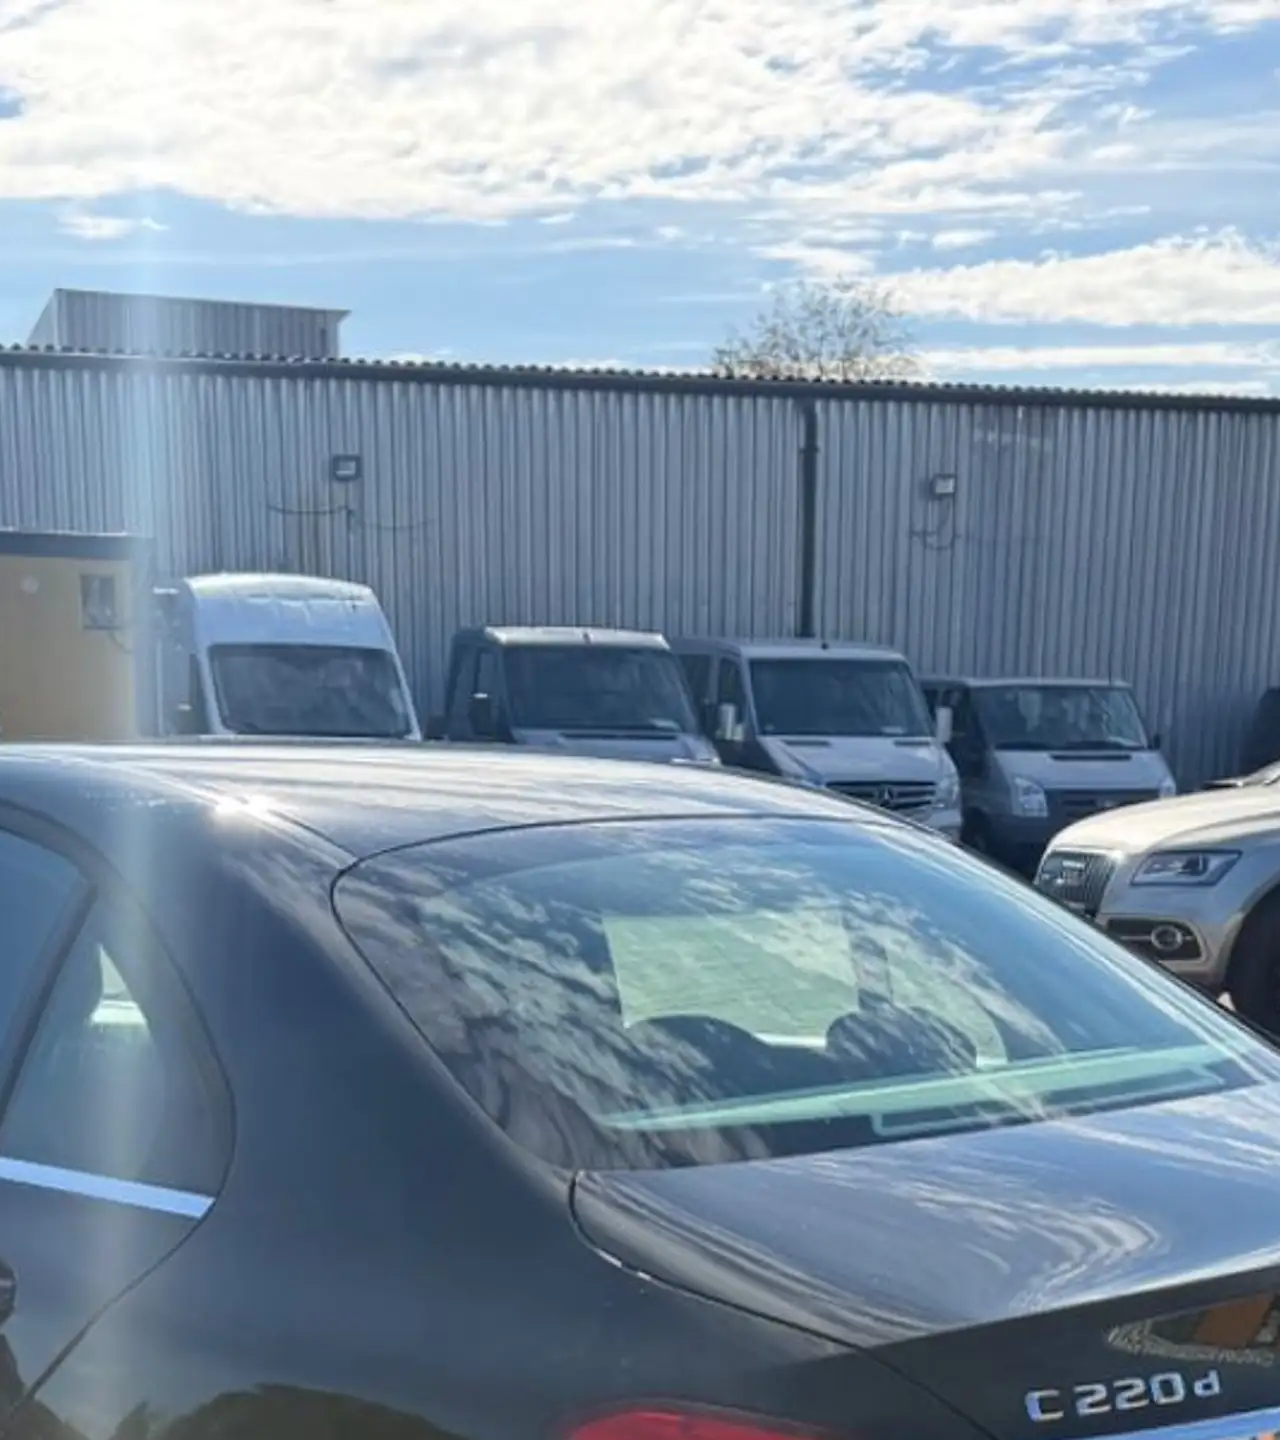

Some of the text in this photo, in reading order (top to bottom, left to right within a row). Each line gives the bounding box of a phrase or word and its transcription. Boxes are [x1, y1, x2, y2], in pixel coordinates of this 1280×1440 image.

[1024, 1369, 1221, 1422] C 220 d
